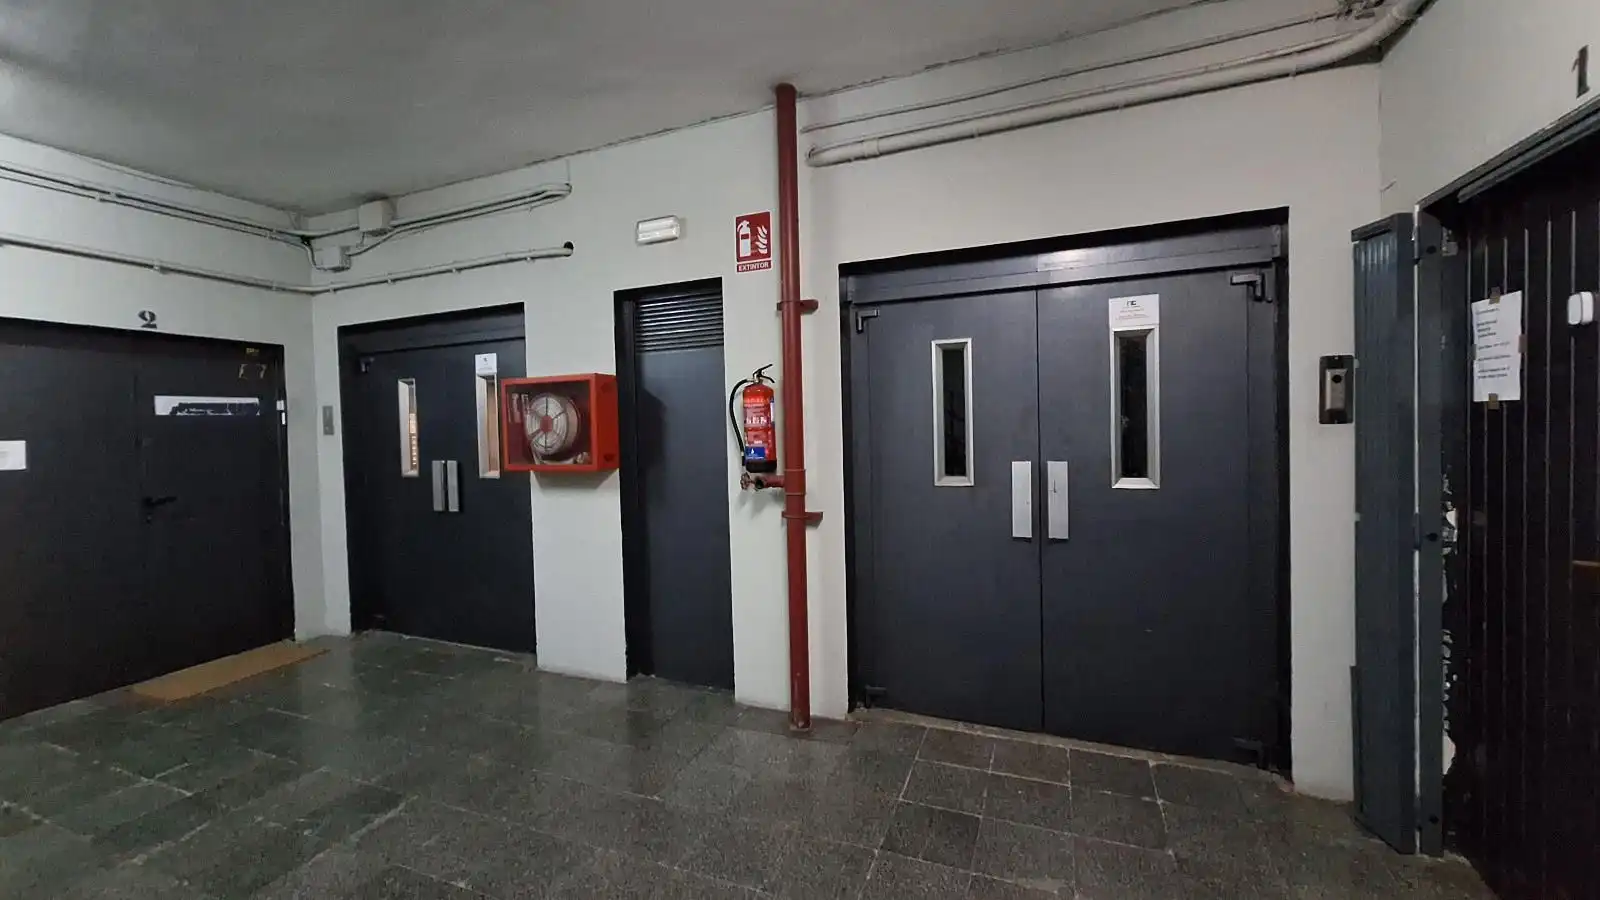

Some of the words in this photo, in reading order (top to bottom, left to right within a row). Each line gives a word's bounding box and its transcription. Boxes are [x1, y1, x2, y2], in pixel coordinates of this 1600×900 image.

[1571, 45, 1590, 99] 1
[738, 262, 769, 271] EXTINTOR
[138, 310, 158, 329] 2
